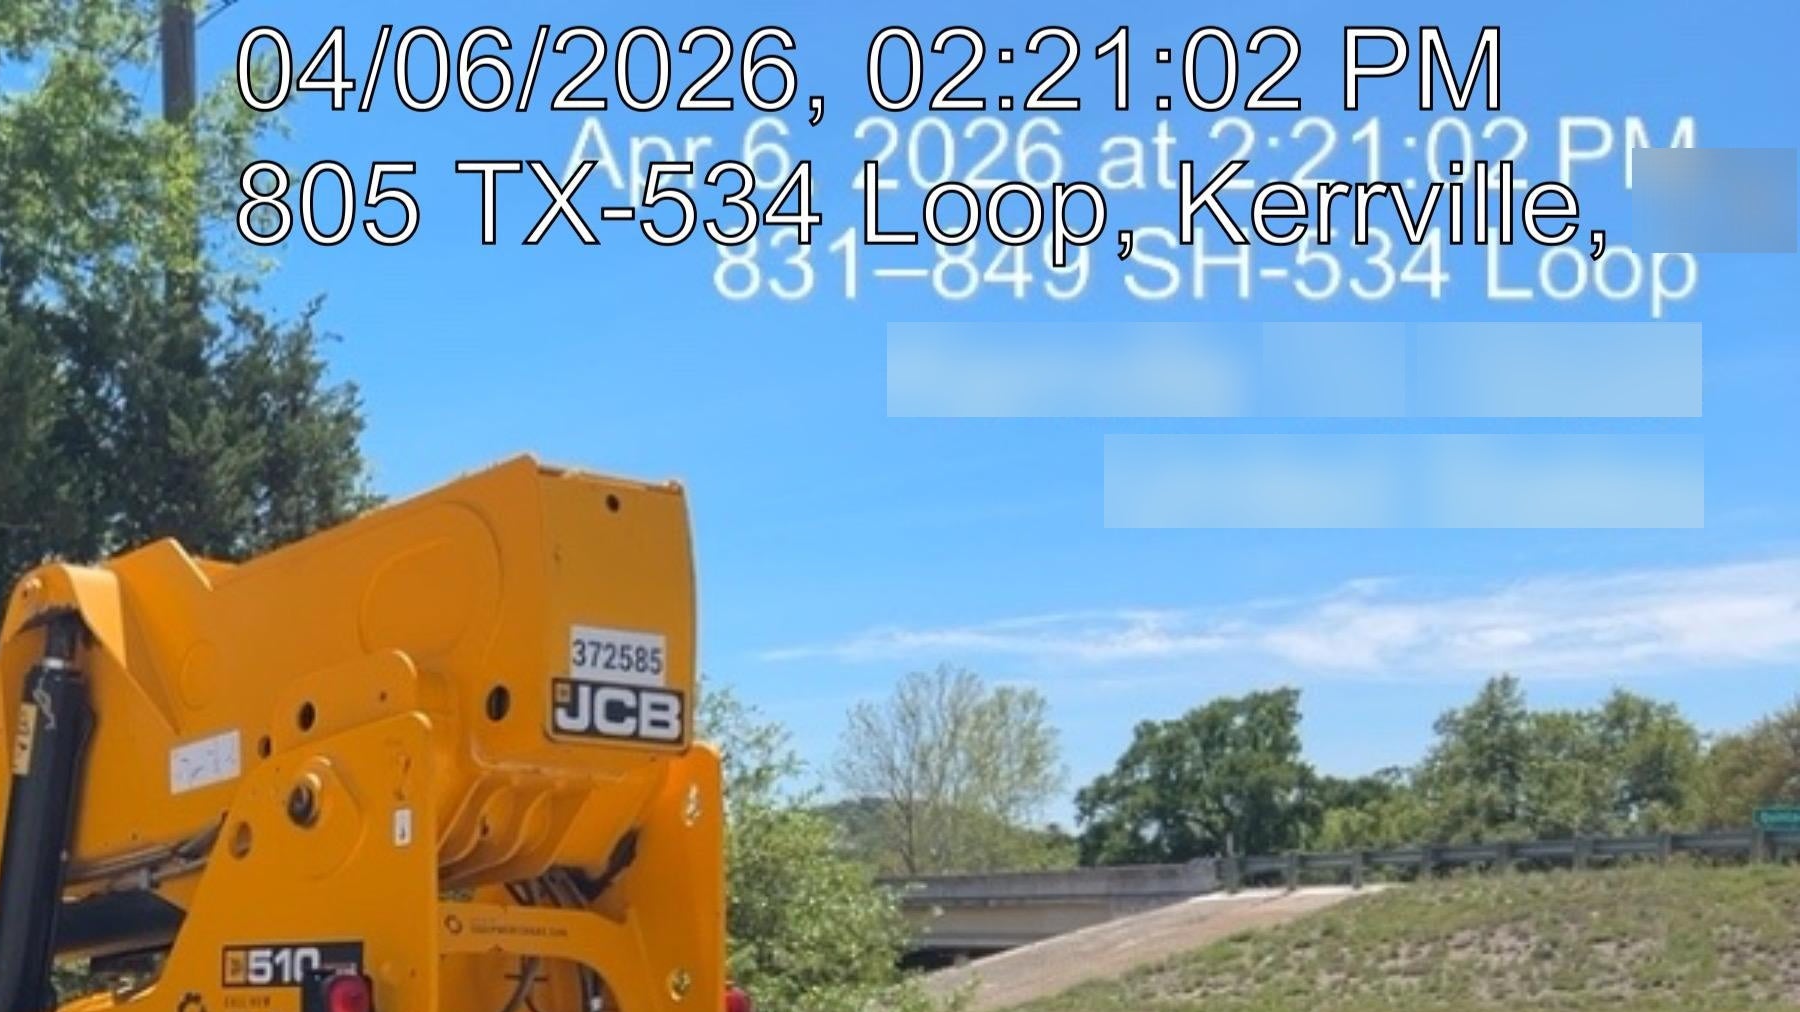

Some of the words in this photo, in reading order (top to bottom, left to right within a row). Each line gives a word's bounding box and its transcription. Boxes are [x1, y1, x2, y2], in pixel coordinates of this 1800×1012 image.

[571, 638, 663, 676] 372585
[555, 683, 681, 740] JCB
[247, 947, 321, 985] 510
